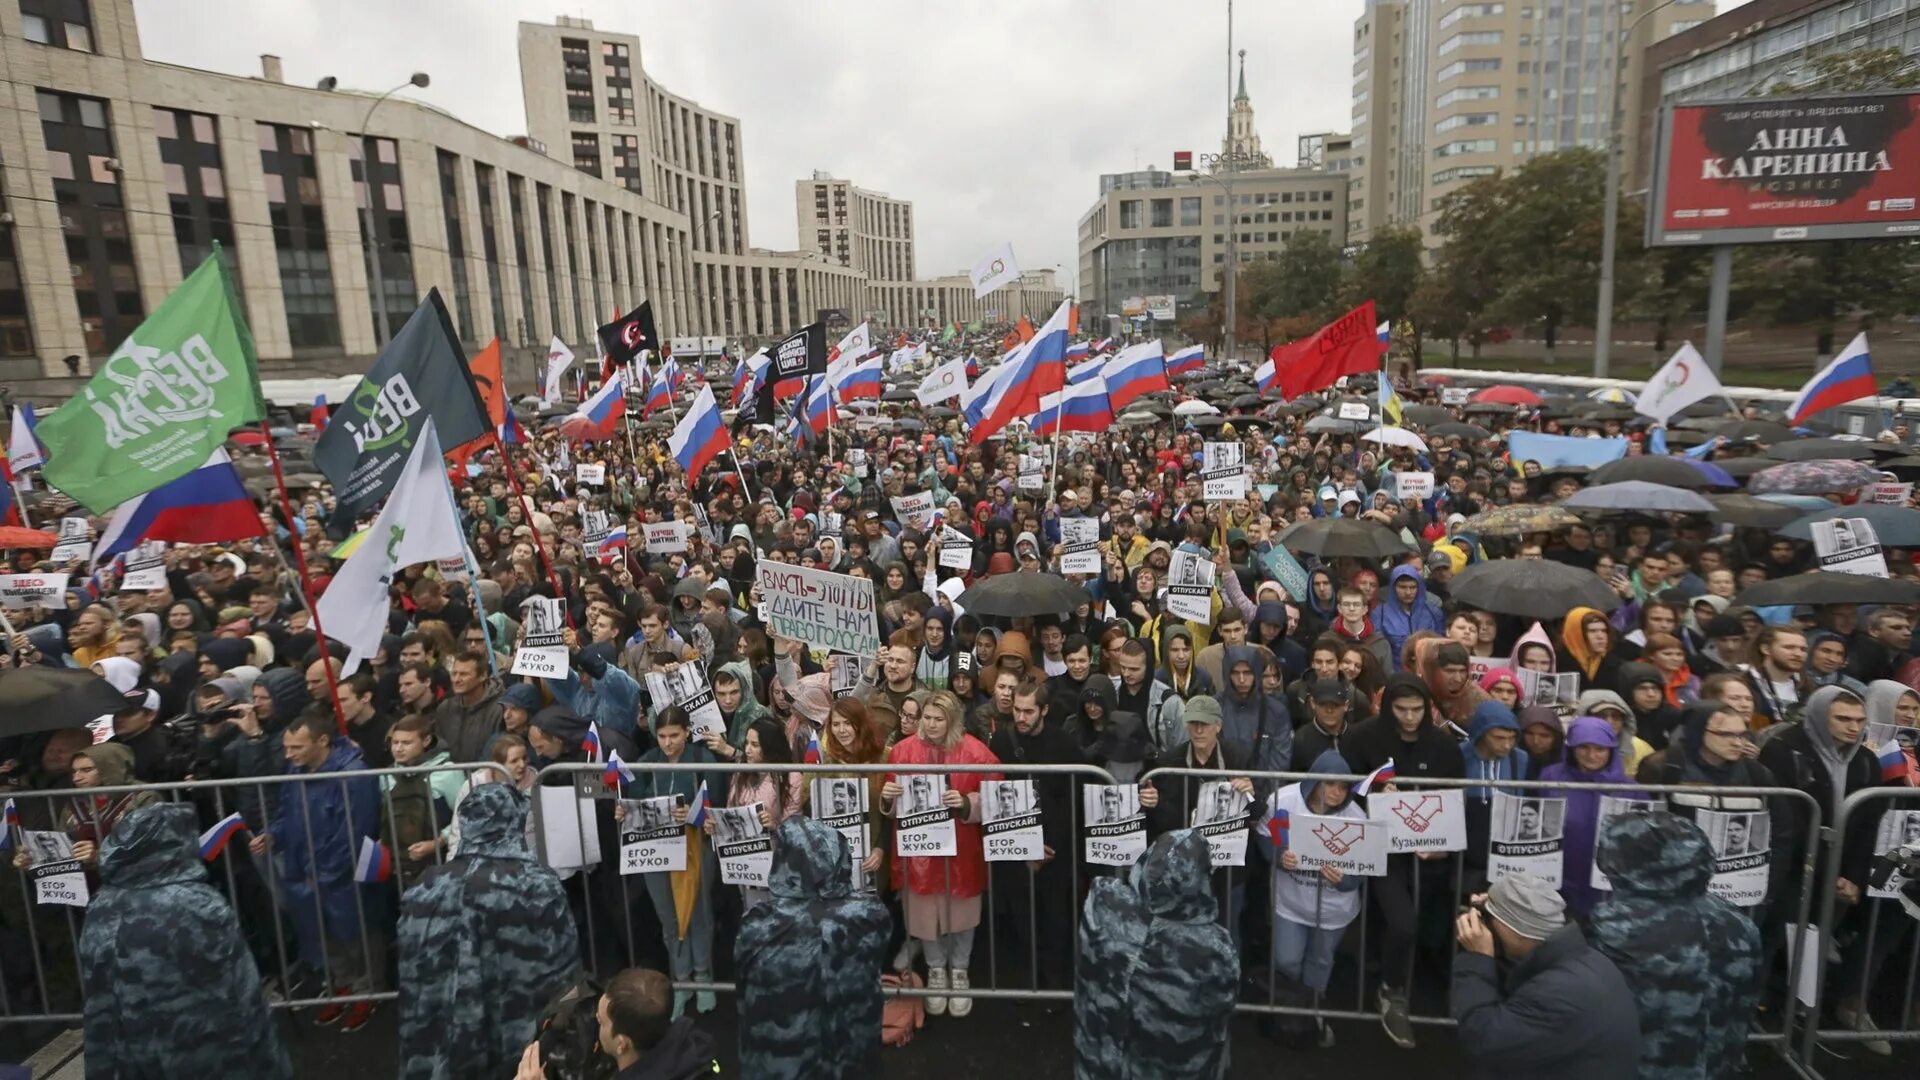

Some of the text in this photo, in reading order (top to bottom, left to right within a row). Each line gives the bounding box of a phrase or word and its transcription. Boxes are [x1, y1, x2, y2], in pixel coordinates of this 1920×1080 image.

[1748, 125, 1850, 151] АННА
[1200, 152, 1271, 163] РОСБАНК
[1701, 149, 1892, 180] КАРЕНИНА
[1207, 469, 1241, 480] ОТПУСКАЙ!
[902, 499, 921, 507] ЗДЕСЬ
[651, 529, 675, 537] ЛУЧШЕ
[650, 536, 680, 545] МИТИНГ!
[1827, 547, 1875, 563] ОТПУСКАЙ!
[1172, 586, 1208, 595] ОТПУСКАЙ!
[772, 595, 825, 624] ДАЙТЕ
[836, 608, 872, 635] НАМ
[1172, 605, 1206, 619] ПОДКОПАЕВ
[526, 636, 562, 646] ОТПУСКАЙ!
[522, 652, 546, 662] ЕГОР
[520, 662, 555, 672] ЖУКОВ
[1470, 663, 1489, 672] ЕСЬ
[684, 694, 709, 712] СКАЙ!
[692, 725, 710, 737] КОВ
[901, 811, 949, 828] ОТПУСКАЙ!
[988, 816, 1037, 833] ОТПУСКАЙ!
[1091, 822, 1141, 836] ОТПУСКАЙ!
[628, 829, 680, 842] ОТПУСКАЙ!
[902, 833, 928, 842] ЕГОР
[902, 842, 941, 851] ЖУКОВ
[989, 839, 1015, 847] ЕГОР
[1091, 842, 1118, 851] ЕГОР
[1391, 836, 1448, 850] Кузьминки
[1498, 840, 1559, 854] ОТПУСКАЙ!
[628, 848, 656, 858] ЕГОР
[724, 841, 767, 856] ОТПУСКАЙ!
[989, 847, 1029, 856] ЖУКОВ
[1091, 850, 1131, 861] ЖУКОВ
[1212, 852, 1232, 860] КОВ
[627, 857, 670, 868] ЖУКОВ
[726, 862, 749, 871] ЕГОР
[1301, 855, 1375, 872] Рязанский р-н
[1497, 863, 1526, 872] ИВАН
[1719, 857, 1766, 872] ПУСКАЙ!
[727, 871, 763, 881] ЖУКОВ
[42, 881, 66, 890] ЕГОР
[42, 890, 77, 900] ЖУКОВ
